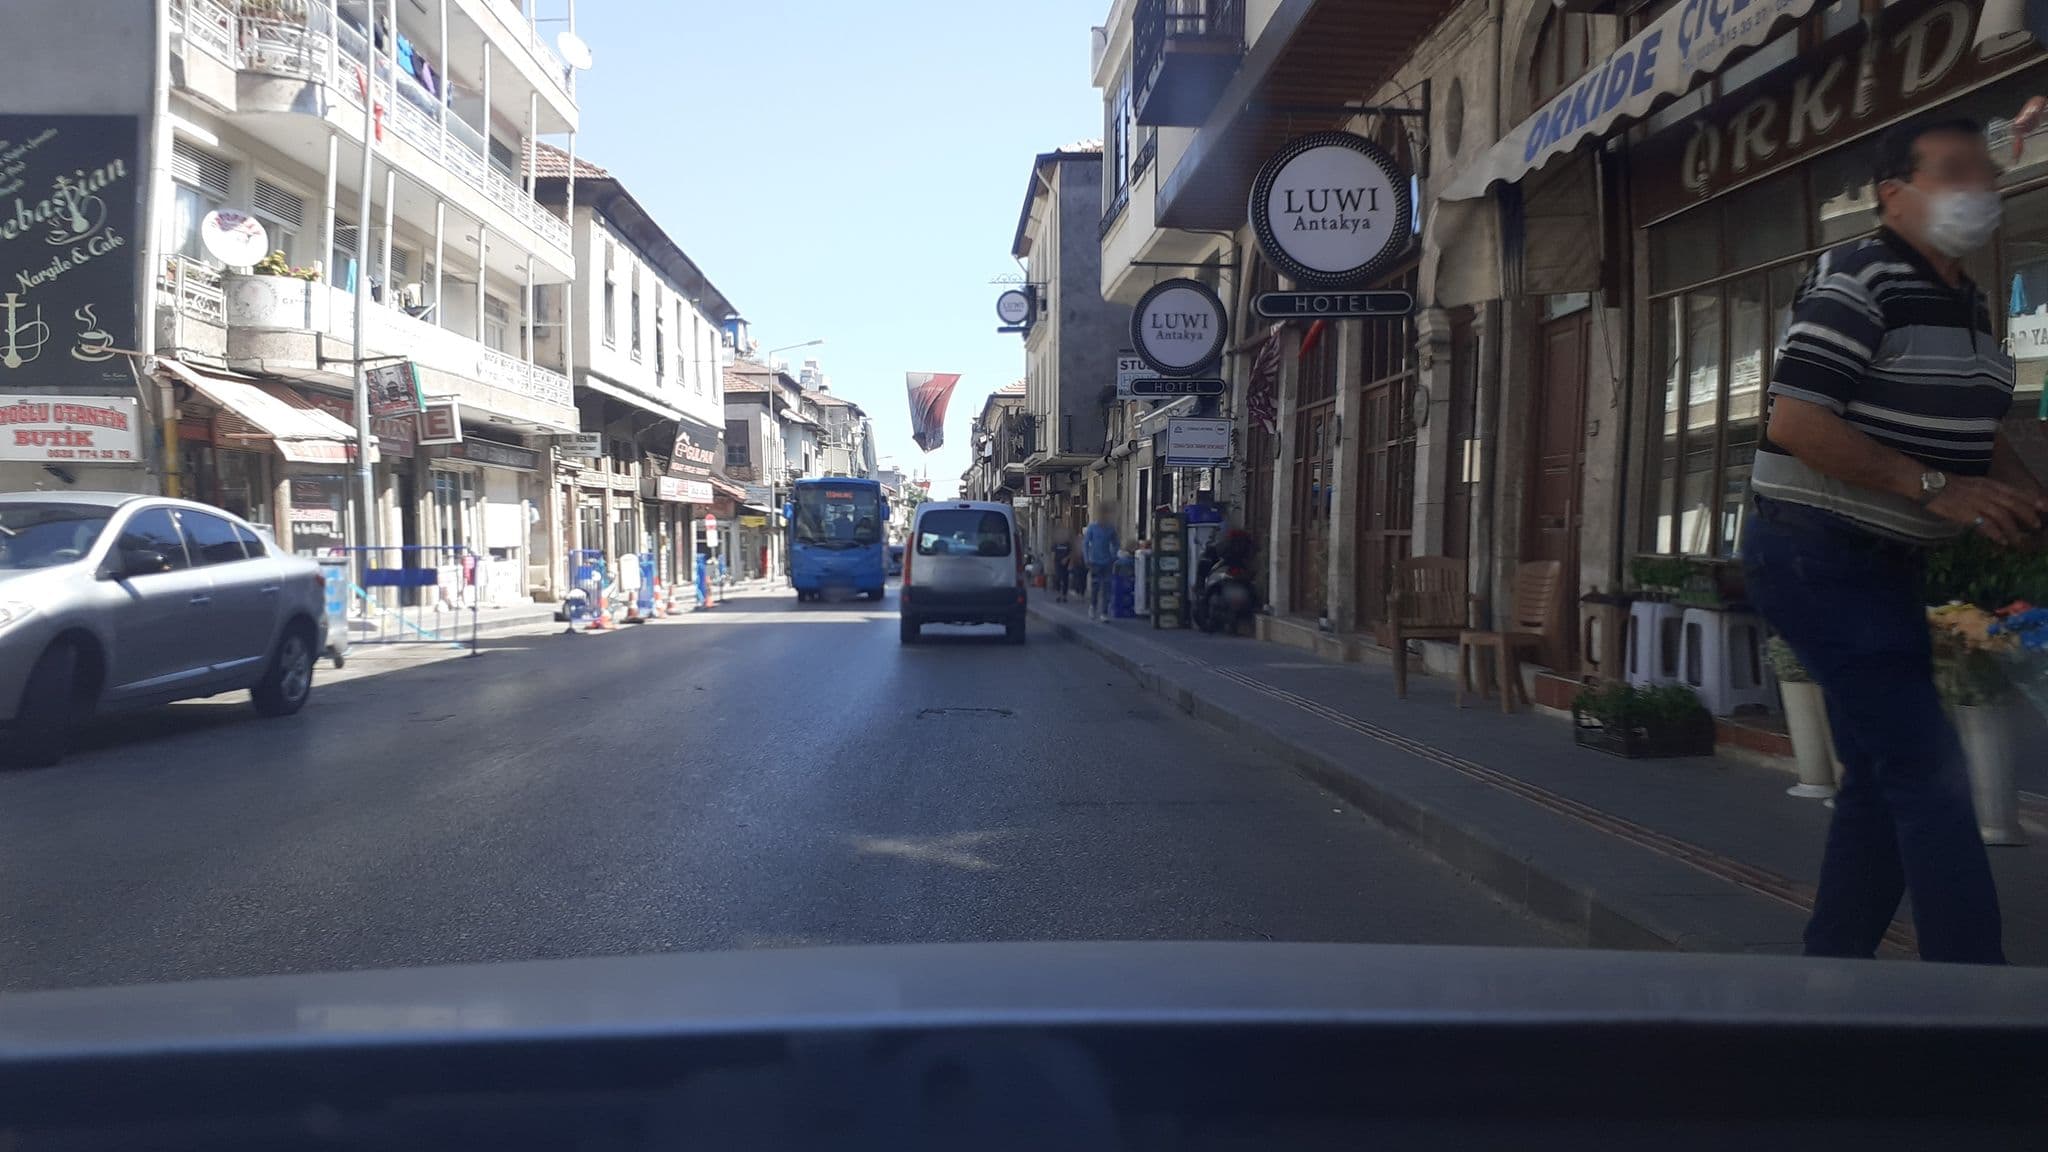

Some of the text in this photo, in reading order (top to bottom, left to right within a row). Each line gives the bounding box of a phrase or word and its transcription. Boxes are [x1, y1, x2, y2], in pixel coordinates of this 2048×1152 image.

[1524, 30, 1663, 162] ORKİDE
[1284, 187, 1380, 214] LUWI
[1293, 214, 1371, 234] Antakya
[15, 226, 126, 295] Nargile & Cafe
[1295, 296, 1375, 312] HOTEL
[1151, 313, 1208, 329] LUWI
[1155, 330, 1203, 342] Antakya
[1120, 360, 1152, 370] STU
[1154, 381, 1202, 392] HOTEL
[54, 403, 129, 431] OTANTİK
[427, 409, 450, 435] E
[14, 425, 95, 447] BUTİK
[1030, 477, 1042, 495] E
